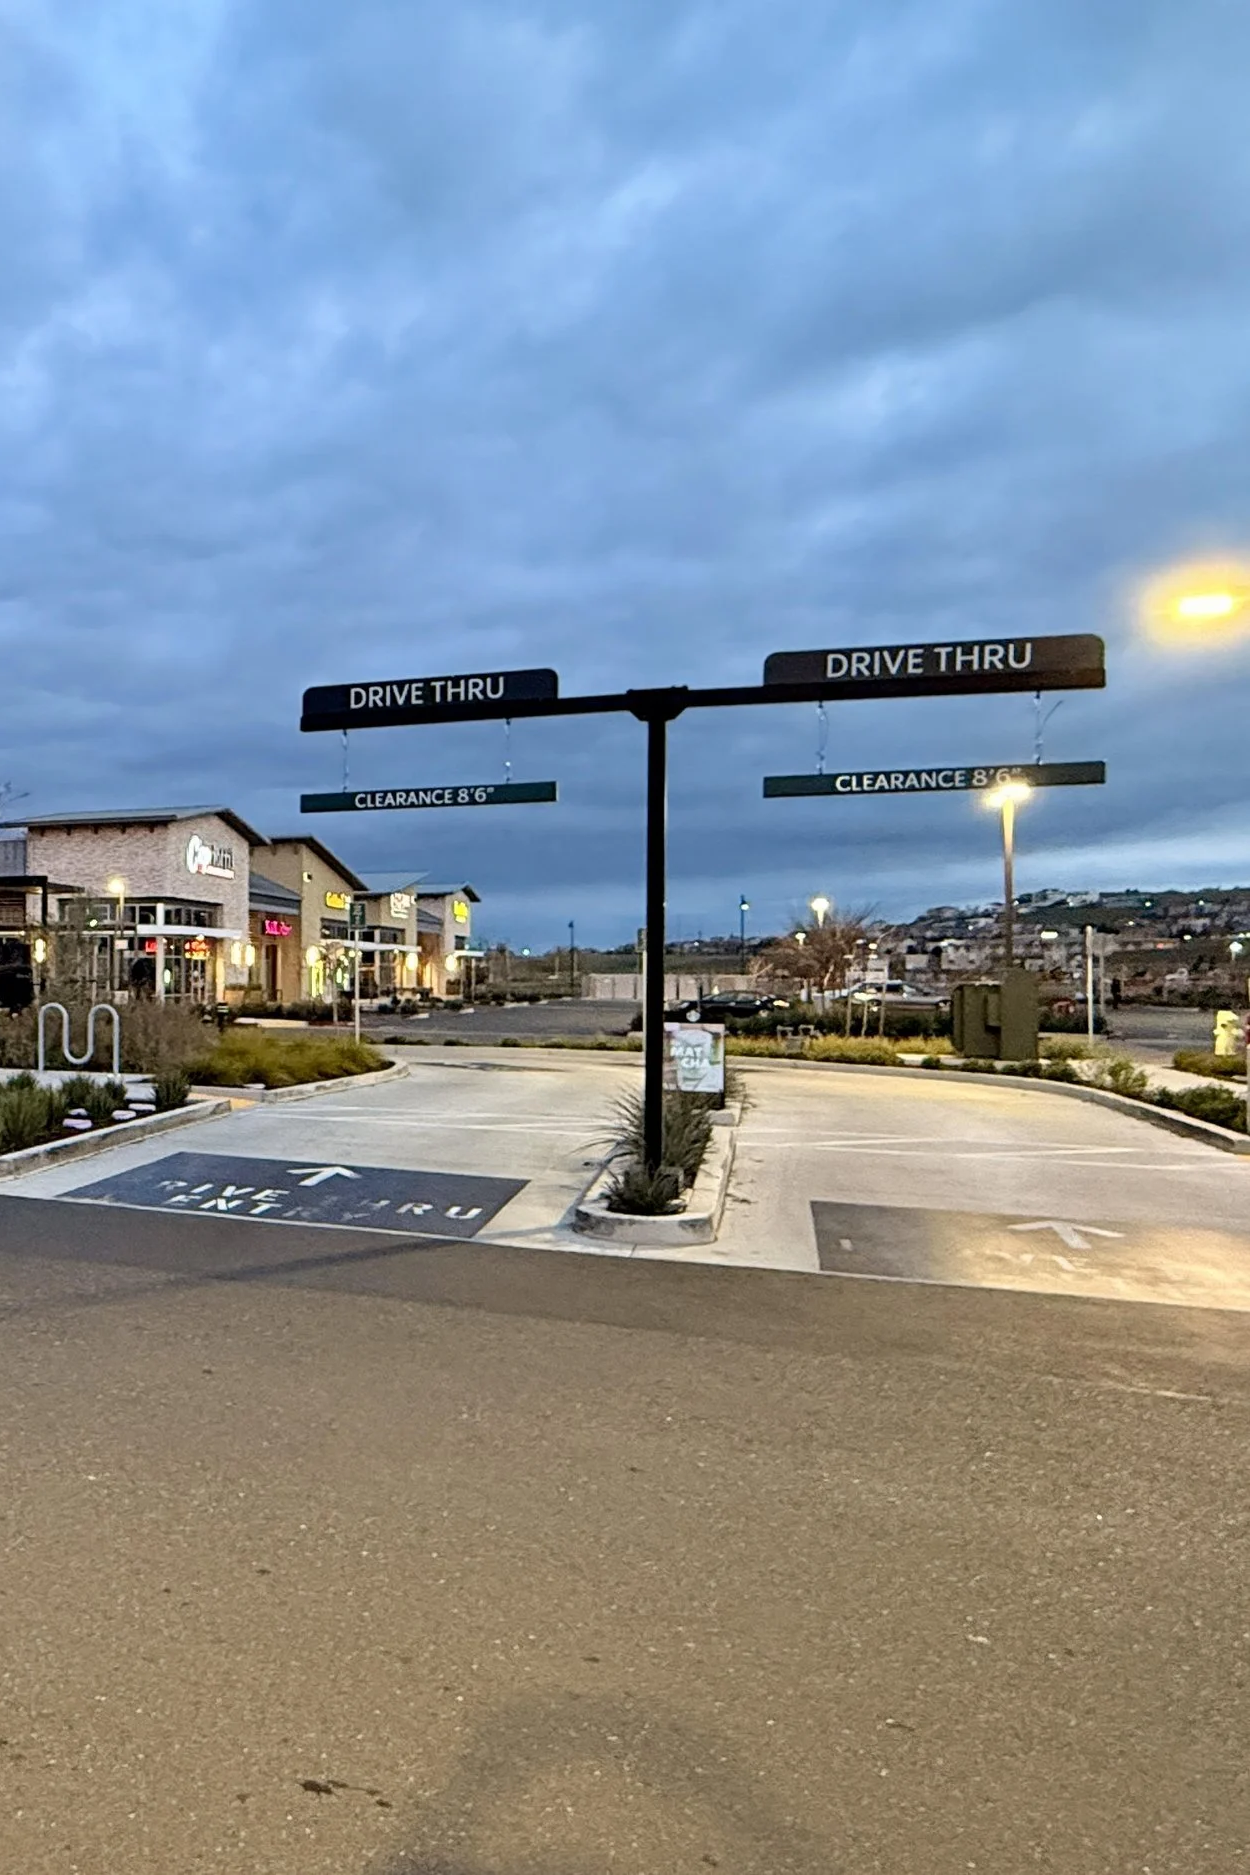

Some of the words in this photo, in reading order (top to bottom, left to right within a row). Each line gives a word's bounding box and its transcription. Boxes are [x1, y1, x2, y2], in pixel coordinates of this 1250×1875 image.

[826, 650, 924, 678] DRIVE
[934, 643, 1032, 672] THRU
[350, 683, 424, 709] DRIVE
[430, 676, 505, 702] THRU
[835, 770, 966, 792] CLEARANCE
[354, 789, 453, 809] CLEARANCE
[153, 1180, 291, 1201] RIVE
